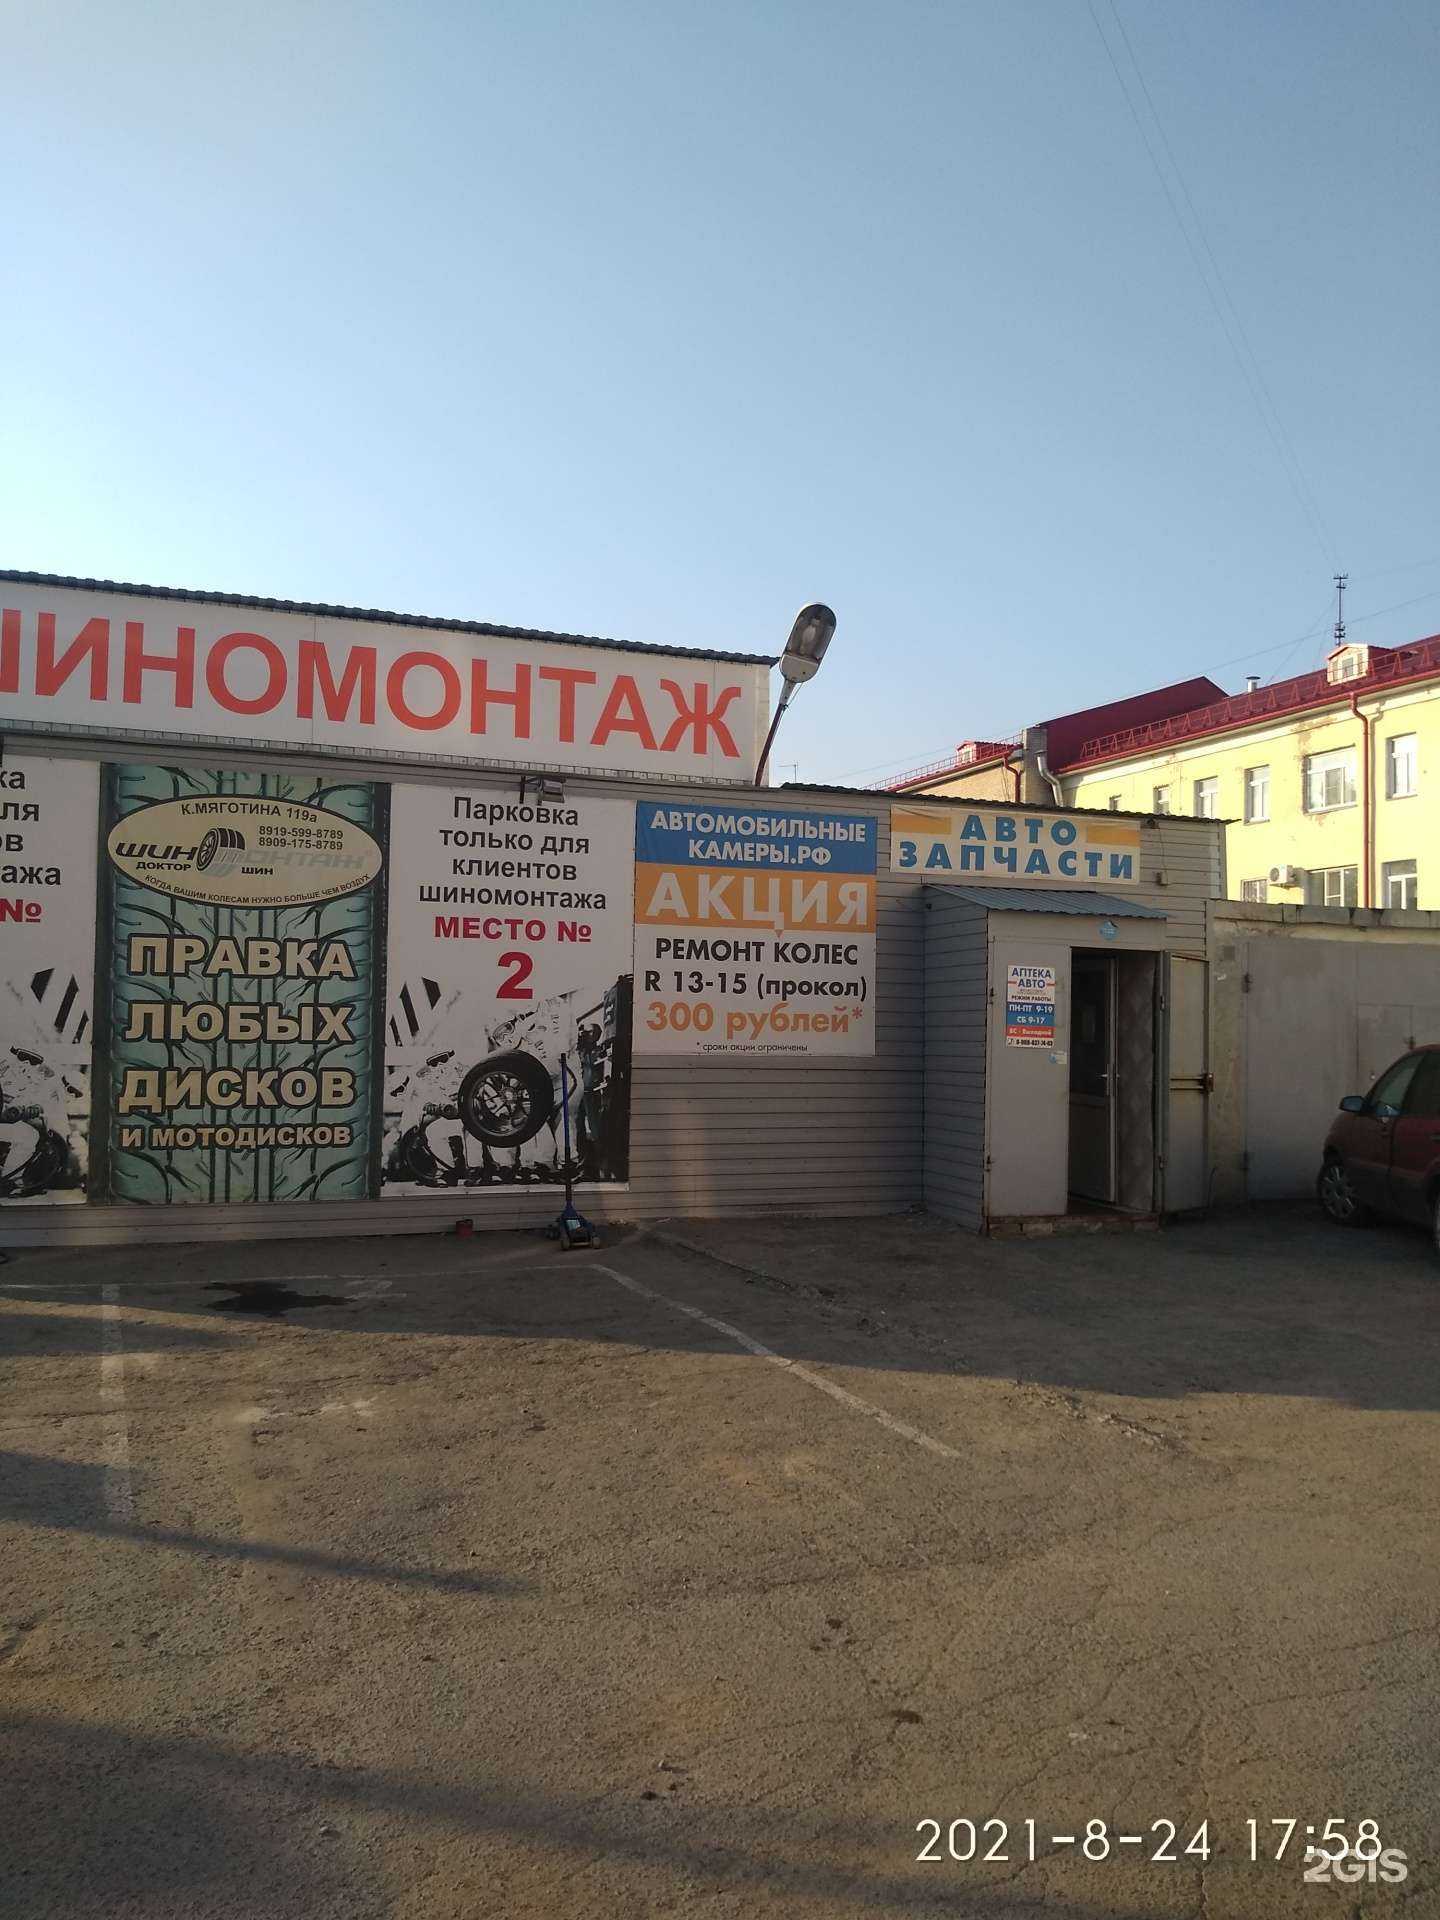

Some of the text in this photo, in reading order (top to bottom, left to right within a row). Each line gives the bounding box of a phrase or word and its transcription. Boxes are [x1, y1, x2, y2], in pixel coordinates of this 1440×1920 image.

[181, 802, 281, 816] К.МЯГОТИНА
[453, 796, 579, 826] Парковка
[258, 826, 344, 840] 8919-599-8789
[650, 810, 866, 842] АВТОМОБИЛЬНЫЕ
[960, 814, 1077, 846] АВТО
[0, 833, 24, 852] в
[258, 837, 343, 850] 8909-175-8789
[439, 829, 590, 855] только для
[688, 839, 832, 866] КАМЕРЫ.РФ
[452, 858, 577, 881] клиентов
[899, 841, 1133, 879] ЗАПЧАСТИ
[144, 874, 172, 892] КОГДА
[173, 886, 206, 900] ВАШИМ
[208, 894, 250, 904] КОЛЕСАМ
[251, 896, 283, 904] НУЖНО
[284, 891, 321, 903] БОЛЬШЕ
[321, 886, 340, 897] ЧЕМ
[419, 885, 607, 909] шиномонтажа
[646, 872, 869, 930] АКЦИЯ
[434, 916, 592, 943] МЕСТО №
[128, 935, 356, 979] ПРАВКА
[655, 937, 858, 965] РЕМОНТ КОЛЕС
[496, 951, 534, 1000] 2
[645, 971, 867, 1001] R 13-15 (прокол)
[1011, 967, 1052, 978] АПТЕКА
[1017, 979, 1046, 988] АВТО
[124, 1002, 354, 1042] ЛЮБЫХ
[646, 1001, 714, 1032] 300
[1009, 1004, 1053, 1014] ПН-ПТ 9-19
[702, 1044, 808, 1054] сроки акции ограничены
[117, 1068, 356, 1114] ДИСКОВ
[121, 1125, 352, 1149] И МОТОДИСКОВ
